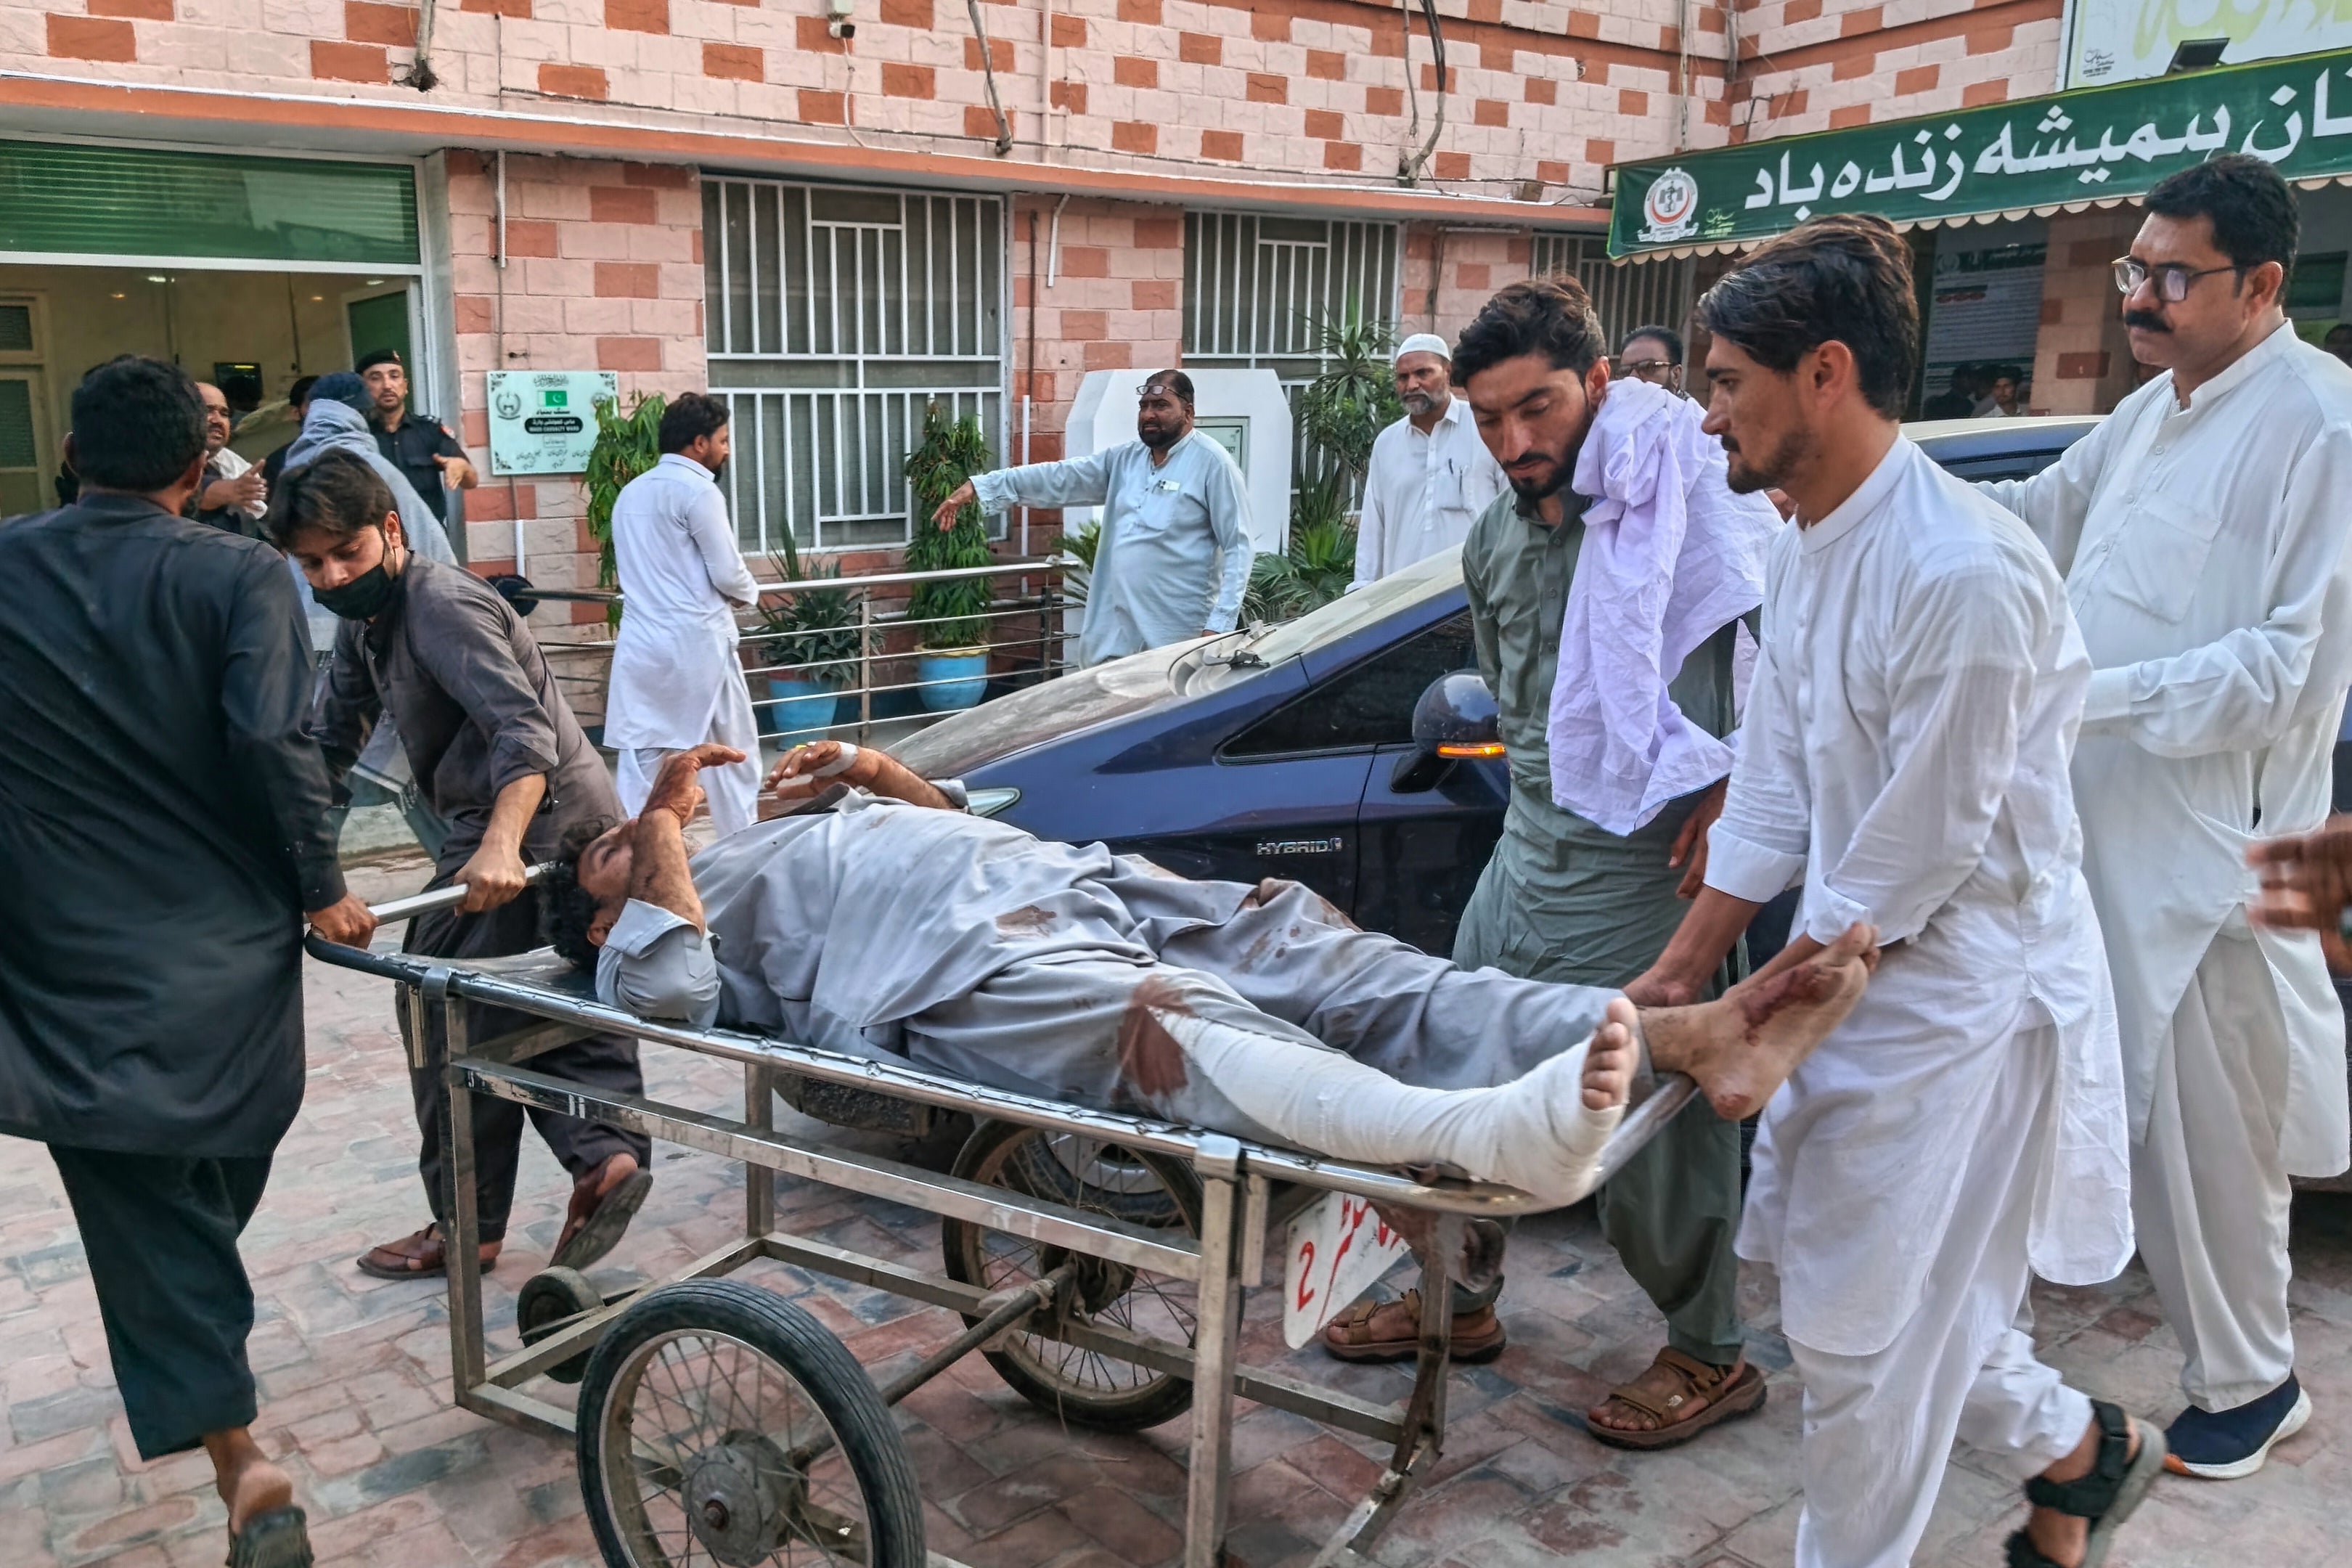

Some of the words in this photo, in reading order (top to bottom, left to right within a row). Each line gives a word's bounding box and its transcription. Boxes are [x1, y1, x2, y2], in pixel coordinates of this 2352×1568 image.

[1744, 149, 1825, 222] باد
[1830, 123, 1964, 201] زندہ
[1257, 840, 1328, 855] HYBRID
